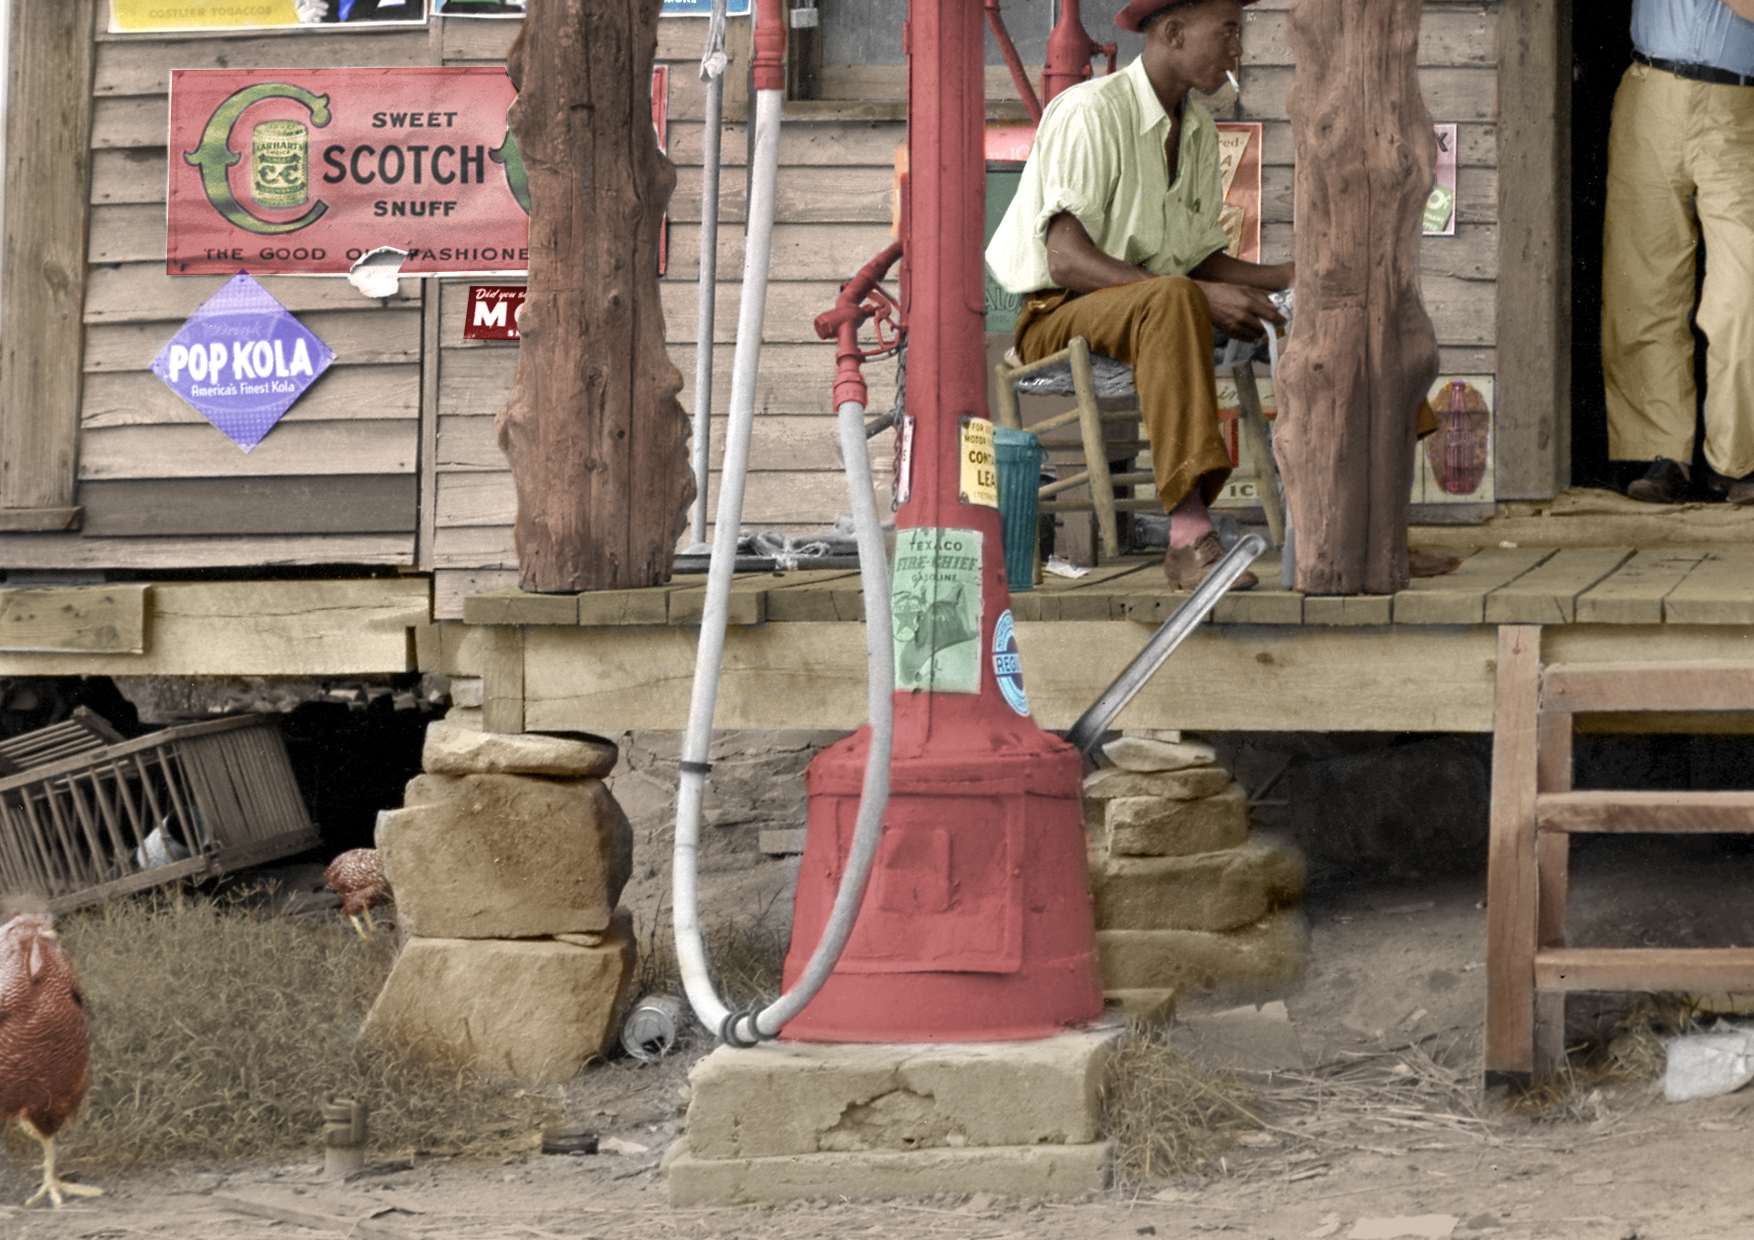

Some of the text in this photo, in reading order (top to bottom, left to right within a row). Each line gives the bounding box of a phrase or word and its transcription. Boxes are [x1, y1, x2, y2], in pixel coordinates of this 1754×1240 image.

[371, 112, 458, 128] SWEET
[322, 144, 484, 185] SCOTCH
[373, 200, 458, 217] SNUFF
[203, 247, 326, 261] THE GOOD
[475, 288, 517, 303] Did you
[168, 337, 314, 385] POP KOLA
[191, 380, 295, 398] America's Finest Kola
[971, 422, 984, 432] FOR
[964, 435, 987, 445] MOTOR
[977, 469, 996, 488] LEA
[909, 540, 963, 552] TEXACO
[911, 573, 957, 583] GASOLINE
